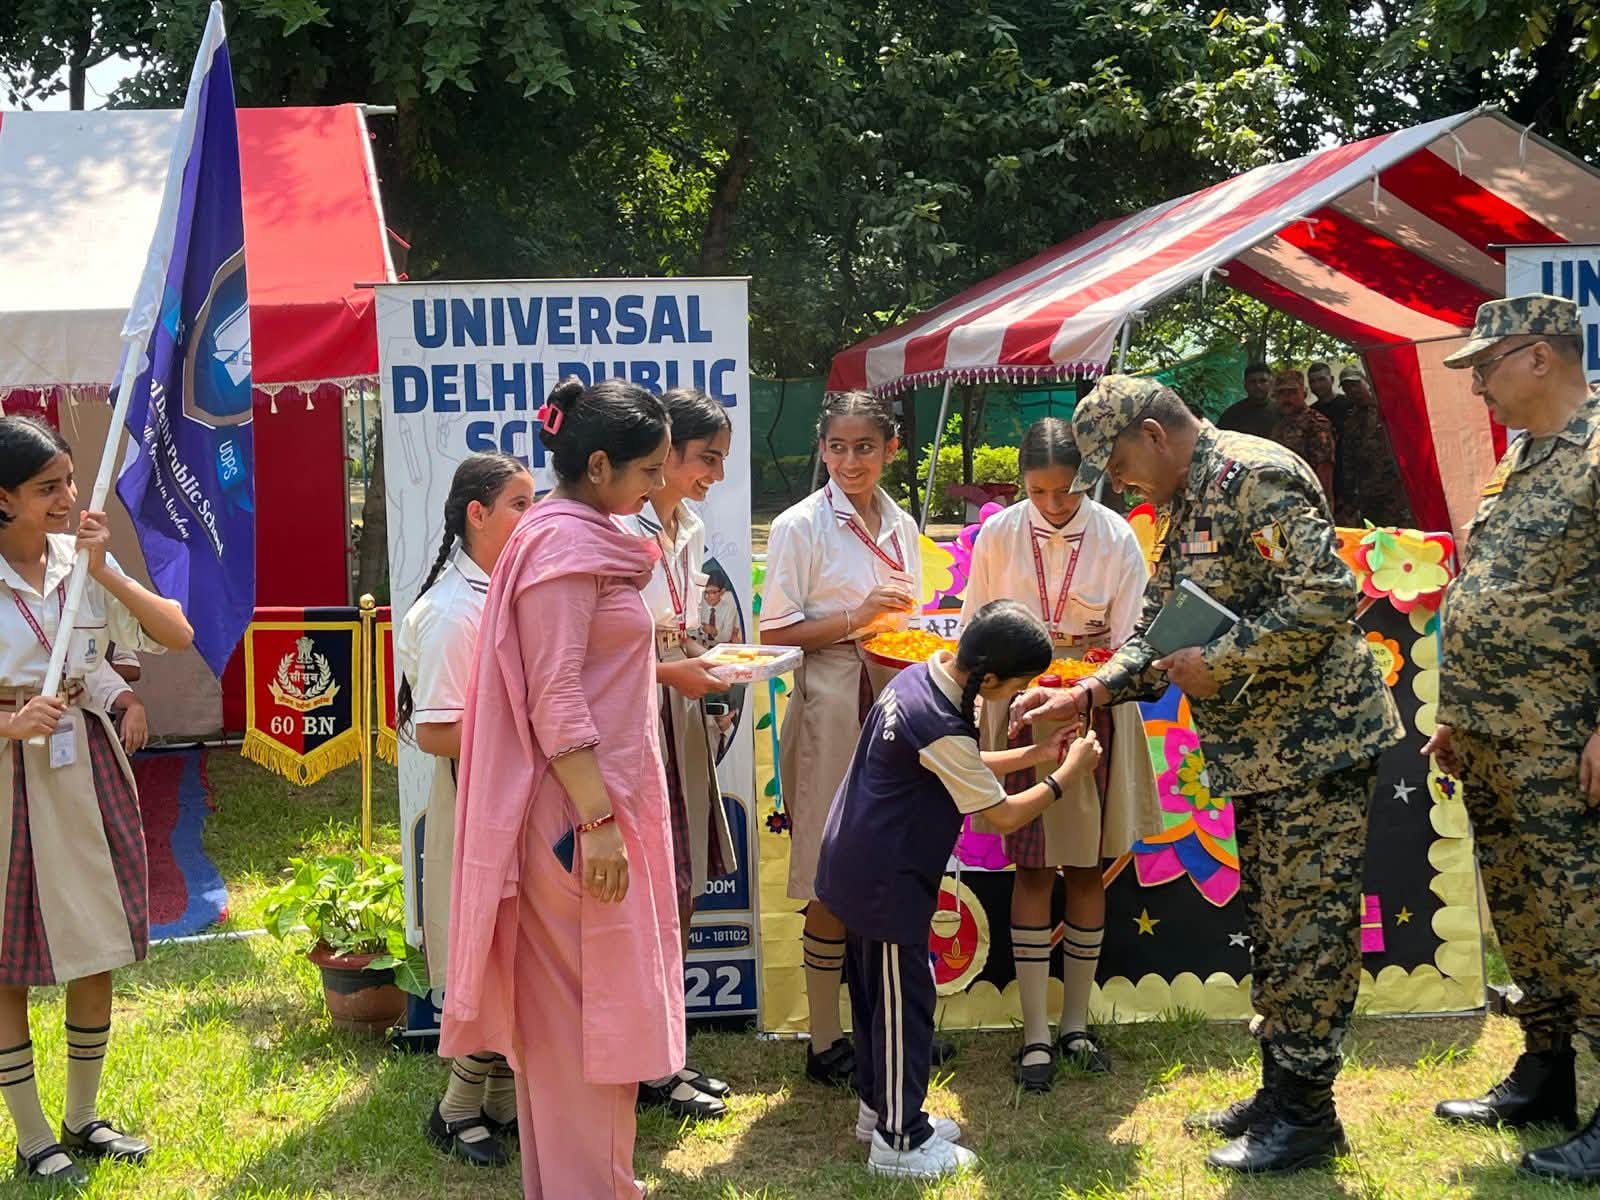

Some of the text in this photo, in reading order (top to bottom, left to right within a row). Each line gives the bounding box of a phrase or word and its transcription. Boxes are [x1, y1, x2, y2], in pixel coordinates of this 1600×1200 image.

[413, 294, 713, 349] UNIVERSAL
[391, 362, 543, 413] DELHI
[155, 395, 173, 447] Delhi
[167, 443, 203, 504] Public
[197, 499, 224, 557] School
[219, 439, 238, 481] UDPS
[271, 715, 336, 735] 60 BN
[713, 929, 748, 942] 181102
